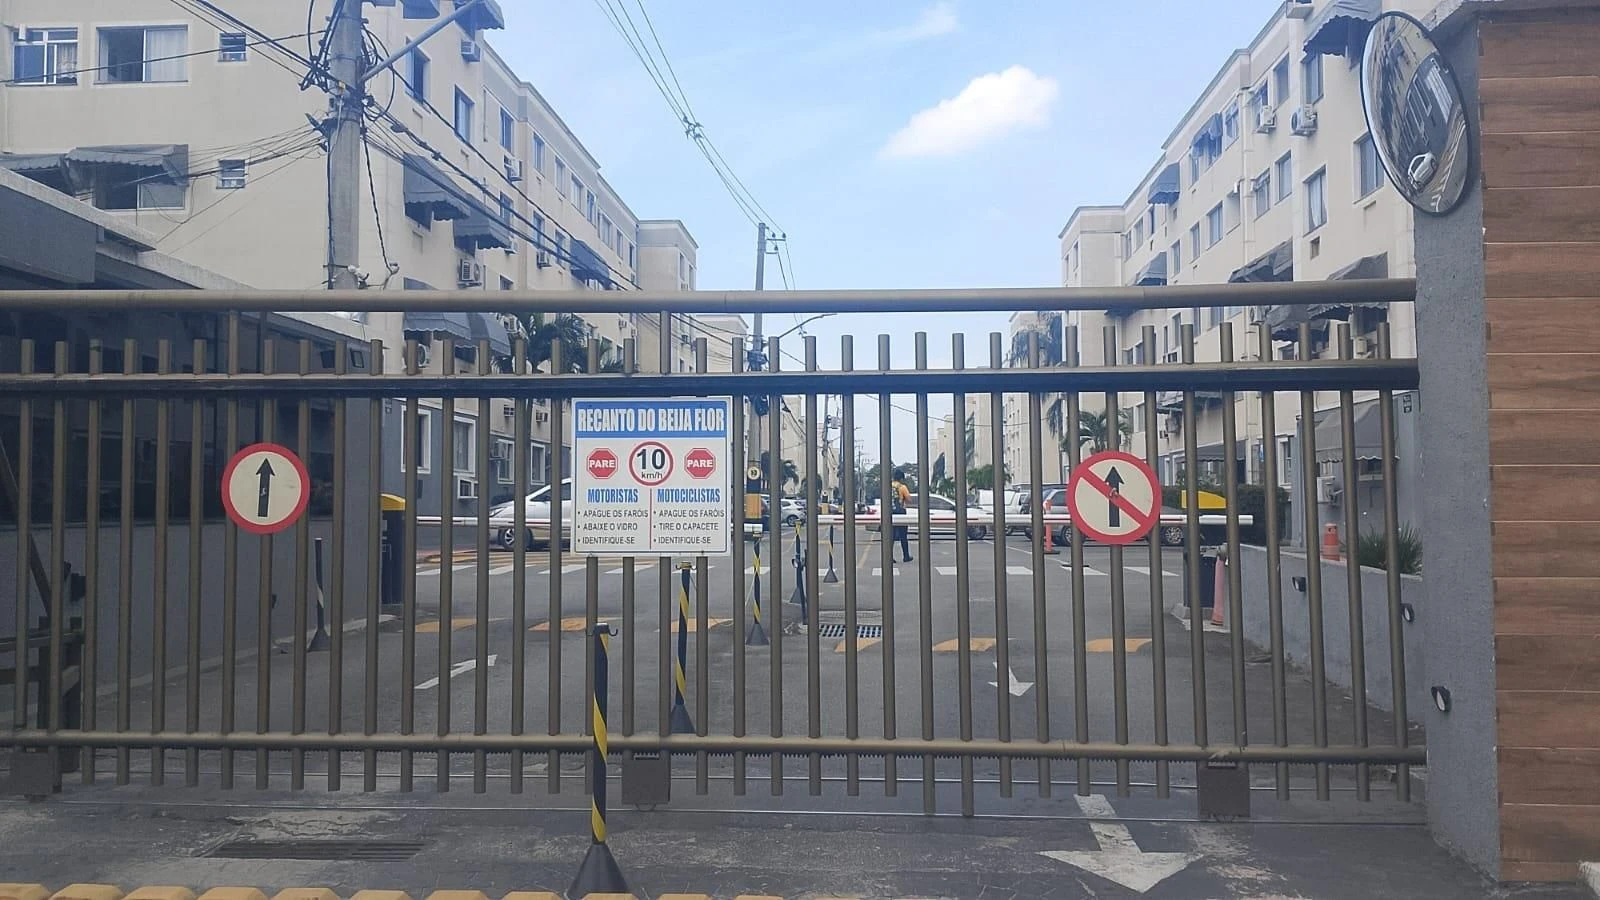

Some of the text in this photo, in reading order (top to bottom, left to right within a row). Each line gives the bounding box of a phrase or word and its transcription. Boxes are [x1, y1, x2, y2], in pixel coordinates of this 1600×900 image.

[577, 408, 725, 432] RECANTO DO BEIJA FLOR
[637, 448, 666, 470] 10
[589, 459, 615, 469] PARE
[687, 459, 713, 469] PARE
[641, 471, 663, 479] km/h
[587, 488, 639, 503] MOTORISTAS
[657, 488, 720, 503] MOTOCICLISTAS
[583, 510, 610, 518] APAGUE
[613, 510, 622, 518] OS
[659, 510, 686, 518] APAGUE
[689, 510, 698, 518] OS
[583, 523, 638, 531] ABAIXE O VIDRO
[659, 523, 718, 531] TIRE O CAPACETE
[582, 537, 635, 545] IDENTIFIQUE-SE
[658, 537, 711, 545] IDENTIFIQUE-SE
